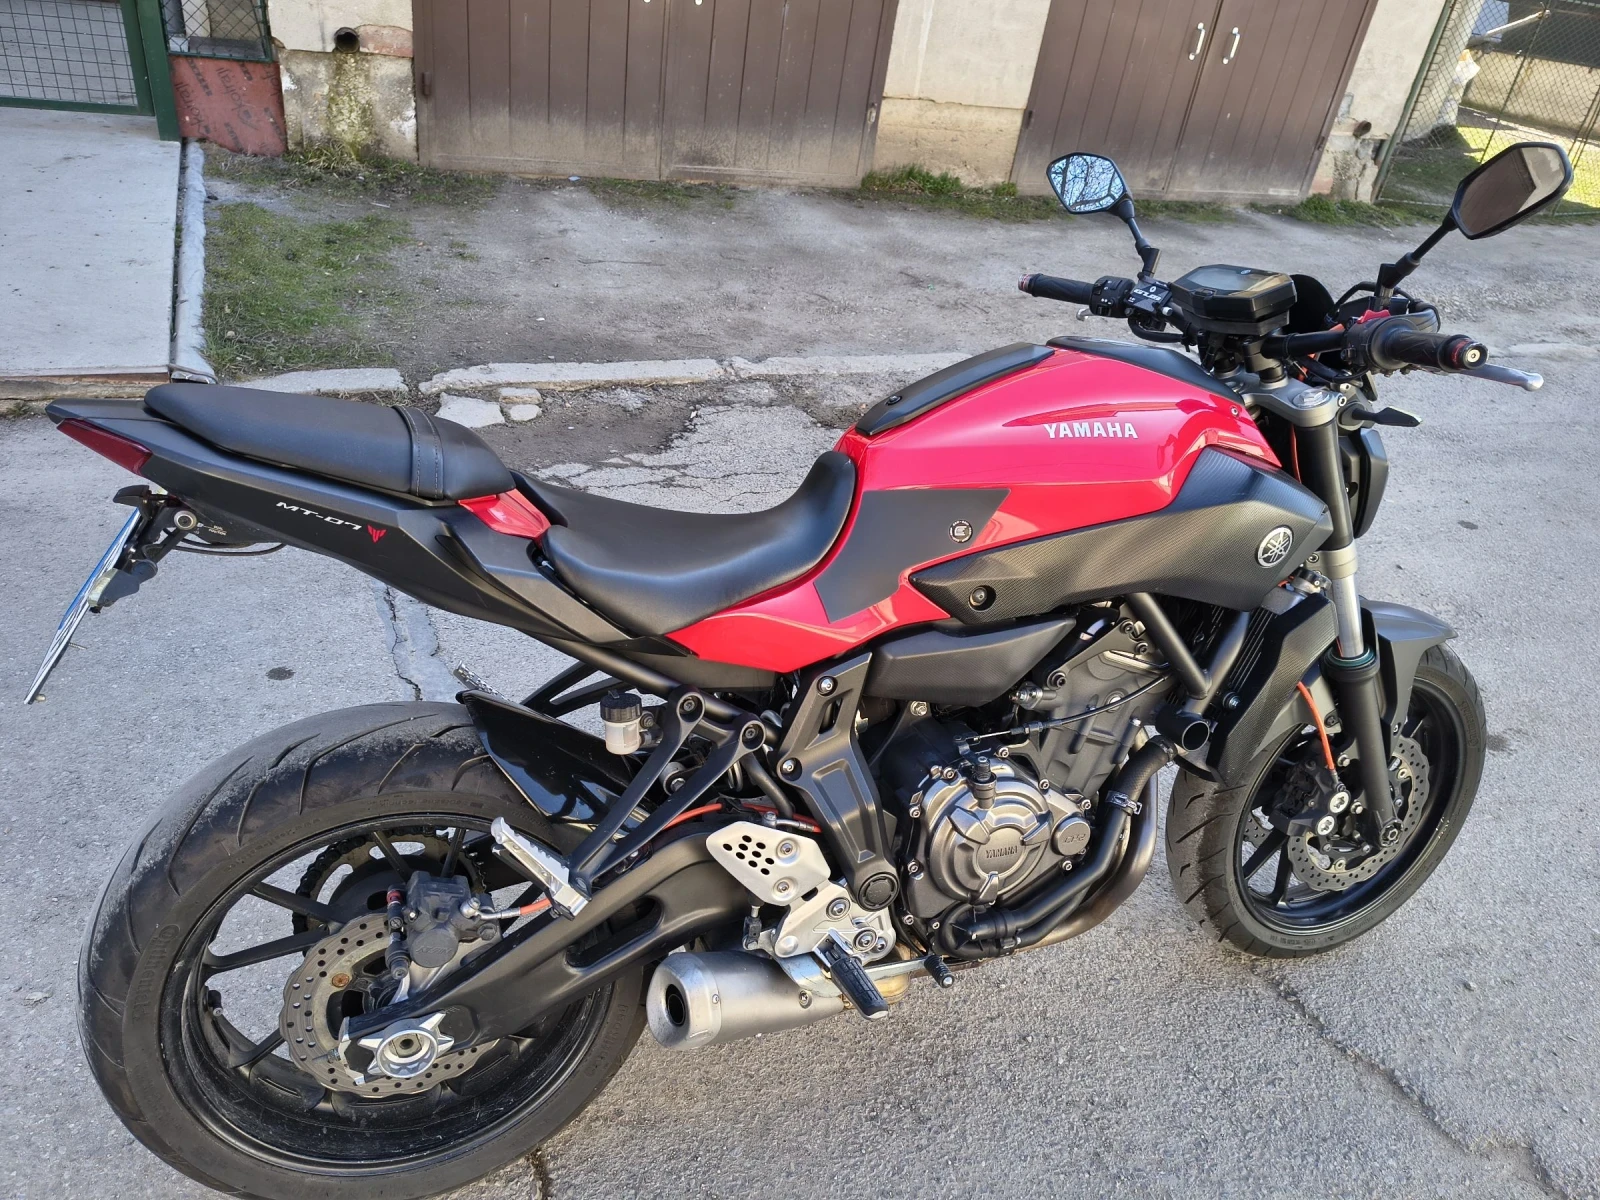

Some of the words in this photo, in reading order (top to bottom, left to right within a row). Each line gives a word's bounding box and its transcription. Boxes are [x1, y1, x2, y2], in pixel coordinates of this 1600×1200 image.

[1043, 421, 1139, 439] YAMAHA
[276, 501, 362, 531] MT-07
[985, 845, 1018, 859] YAMAHA
